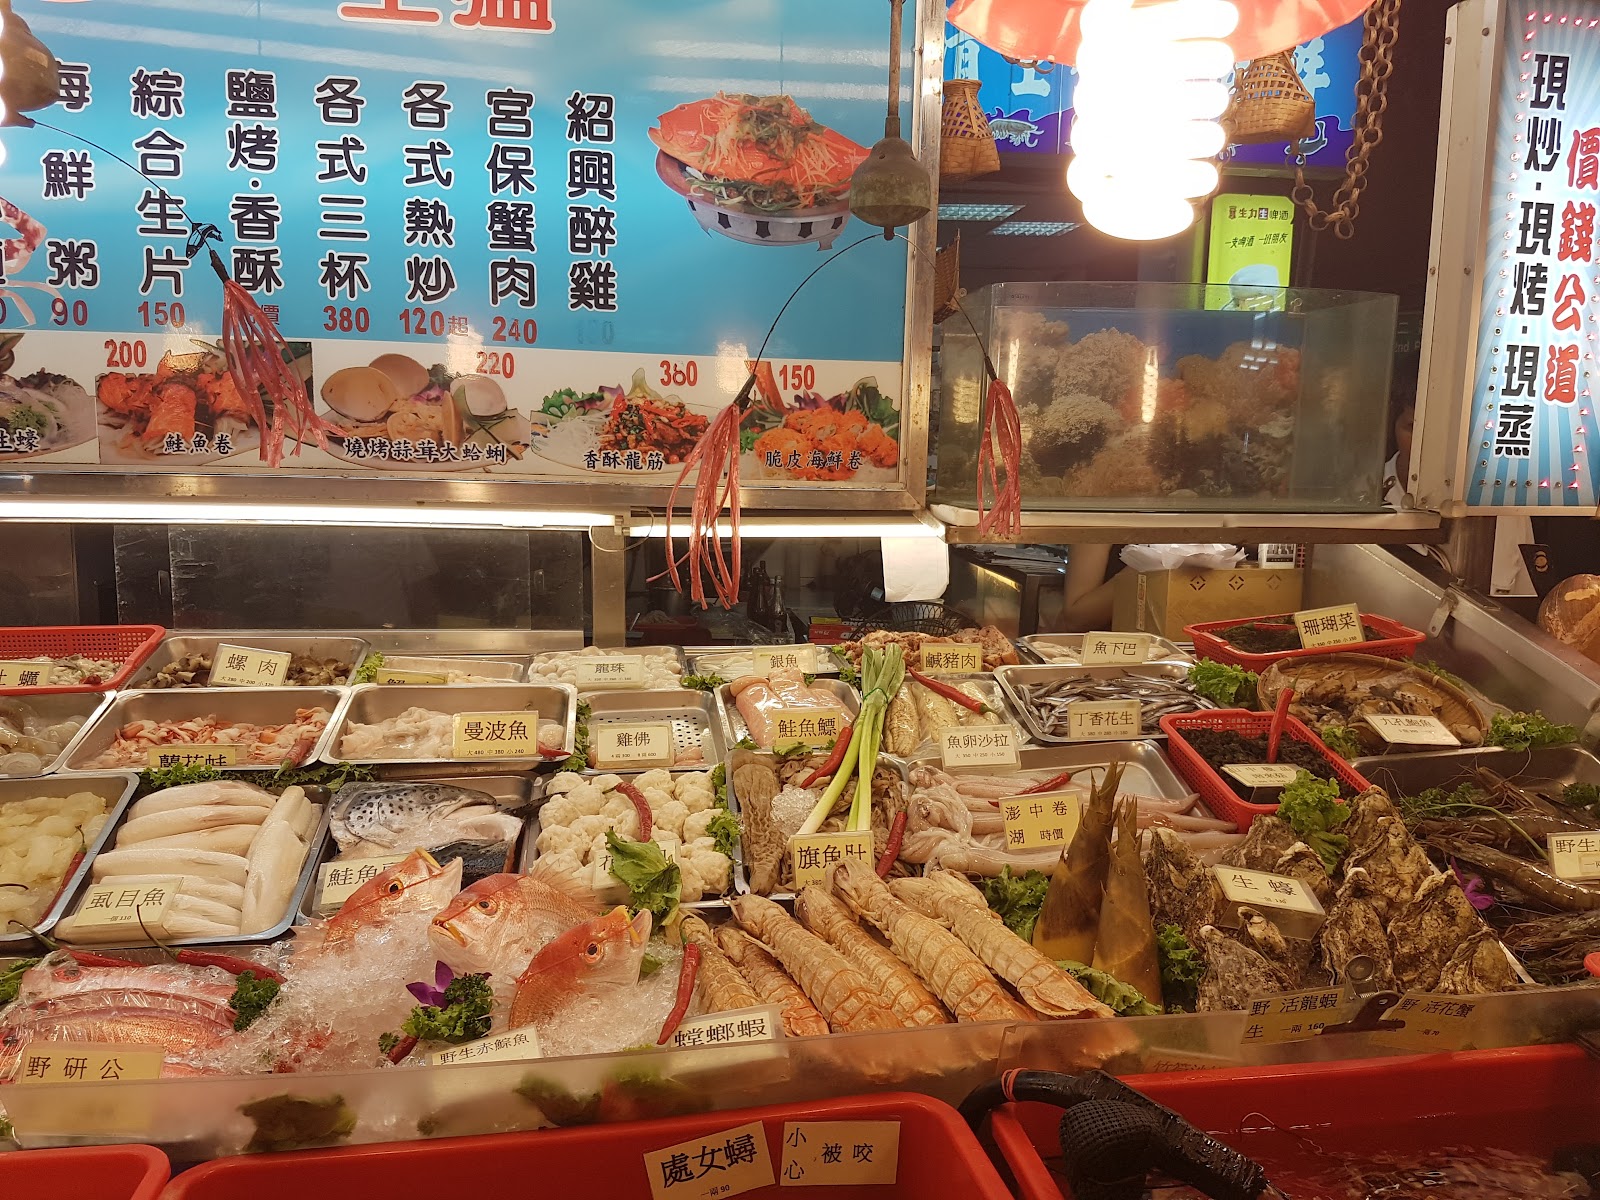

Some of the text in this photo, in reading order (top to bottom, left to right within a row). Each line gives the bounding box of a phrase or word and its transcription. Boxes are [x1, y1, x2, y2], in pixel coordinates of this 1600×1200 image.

[133, 69, 189, 296] 綜合生片
[316, 79, 368, 298] 各式三杯
[403, 83, 455, 303] 各式熱炒
[487, 89, 536, 307] 宮保蟹肉
[567, 91, 617, 311] 紹興醉雞
[1546, 128, 1600, 402] 價錢公道
[51, 298, 88, 326] 90
[138, 301, 185, 327] 150
[323, 305, 370, 332] 380
[492, 316, 537, 344] 240
[104, 339, 147, 368] 200
[476, 351, 515, 378] 220
[660, 360, 698, 387] 360
[779, 364, 815, 391] 150
[165, 433, 232, 454] 鮭魚卷
[583, 450, 663, 471] 香酥龍筋
[765, 450, 863, 471] 脆皮海鮮卷
[1301, 612, 1356, 636] 珊瑚菜
[1093, 641, 1136, 655] 魚下巴
[226, 653, 278, 676] 螺肉
[595, 663, 625, 673] 龍珠
[770, 653, 797, 668] 銀魚
[925, 652, 976, 669] 鹹豬肉
[1074, 711, 1134, 726] 丁香花生
[464, 720, 528, 742] 曼波魚
[616, 732, 650, 747] 雞佛
[947, 733, 1010, 749] 魚卵沙拉
[1029, 801, 1068, 820] 中卷
[1040, 828, 1064, 840] 時價
[1556, 838, 1600, 853] 野生
[327, 862, 395, 887] 鮭魚
[1232, 875, 1296, 896] 生蠔
[86, 888, 165, 909] 虱目魚
[1280, 993, 1338, 1013] 活龍蝦
[675, 1018, 767, 1047] 螳螂蝦
[1307, 1022, 1325, 1031] 160
[660, 1133, 757, 1189] 處女蟳
[822, 1142, 873, 1164] 被咬
